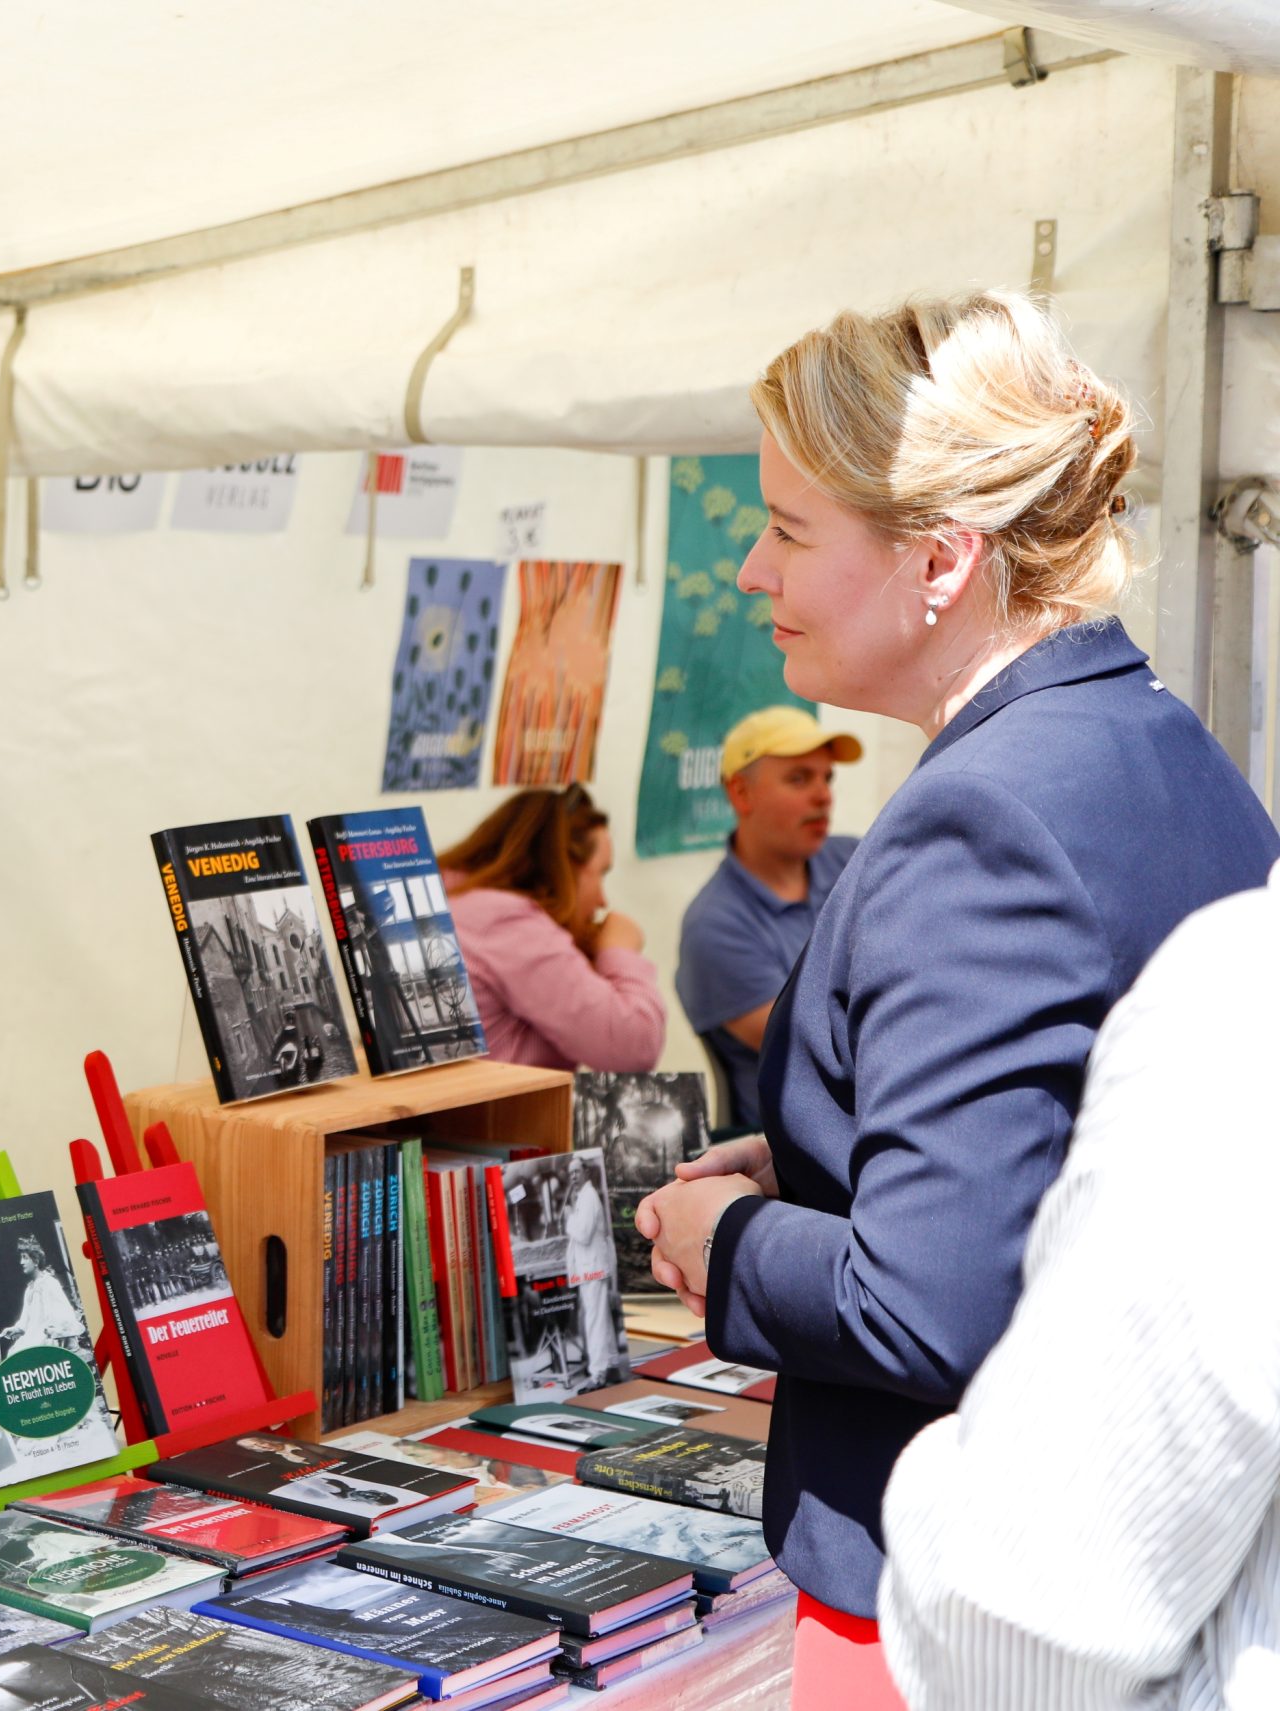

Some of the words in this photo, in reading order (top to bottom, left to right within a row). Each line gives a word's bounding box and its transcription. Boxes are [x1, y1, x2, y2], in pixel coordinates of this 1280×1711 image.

[337, 838, 419, 862] PETERSBURG
[187, 851, 261, 878] VENEDIG
[161, 862, 189, 932] VENEDIG
[315, 847, 348, 940] PETERSBURG
[361, 1181, 371, 1239] ZÜRICH
[374, 1178, 384, 1236] ZÜRICH
[388, 1174, 399, 1232] ZÜRICH
[323, 1190, 332, 1261] VENEDIG
[105, 1280, 117, 1308] FISCHER
[114, 1309, 126, 1335] ERHARD
[146, 1325, 169, 1345] Der
[168, 1309, 230, 1339] Feuerreiter
[122, 1336, 132, 1357] BERND
[1, 1360, 74, 1393] HERMIONE
[6, 1394, 21, 1405] Die
[20, 1389, 43, 1402] Flucht
[43, 1385, 55, 1396] ins
[55, 1380, 77, 1393] Leben
[20, 1418, 32, 1427] Eine
[32, 1413, 55, 1424] poetische
[55, 1406, 77, 1419] Biografie
[32, 1448, 50, 1458] Edition
[594, 1464, 614, 1477] Orte
[618, 1478, 663, 1497] Menschen
[551, 1503, 615, 1531] PERMAFROST
[159, 1524, 185, 1536] Der
[44, 1553, 128, 1584] HERMIONE
[356, 1561, 389, 1579] Inneren
[389, 1570, 402, 1583] im
[509, 1560, 561, 1580] Schnee
[527, 1571, 553, 1585] im
[548, 1556, 603, 1578] Inneren
[402, 1574, 433, 1590] Schnee
[438, 1584, 462, 1598] Subilia
[355, 1594, 420, 1623] Männer
[463, 1590, 508, 1609] Anne-Sophie
[382, 1612, 408, 1624] vom
[401, 1607, 448, 1628] Meer
[110, 1657, 133, 1671] Die
[131, 1642, 171, 1662] Mühle
[154, 1653, 177, 1665] von
[430, 1650, 458, 1664] EDITION
